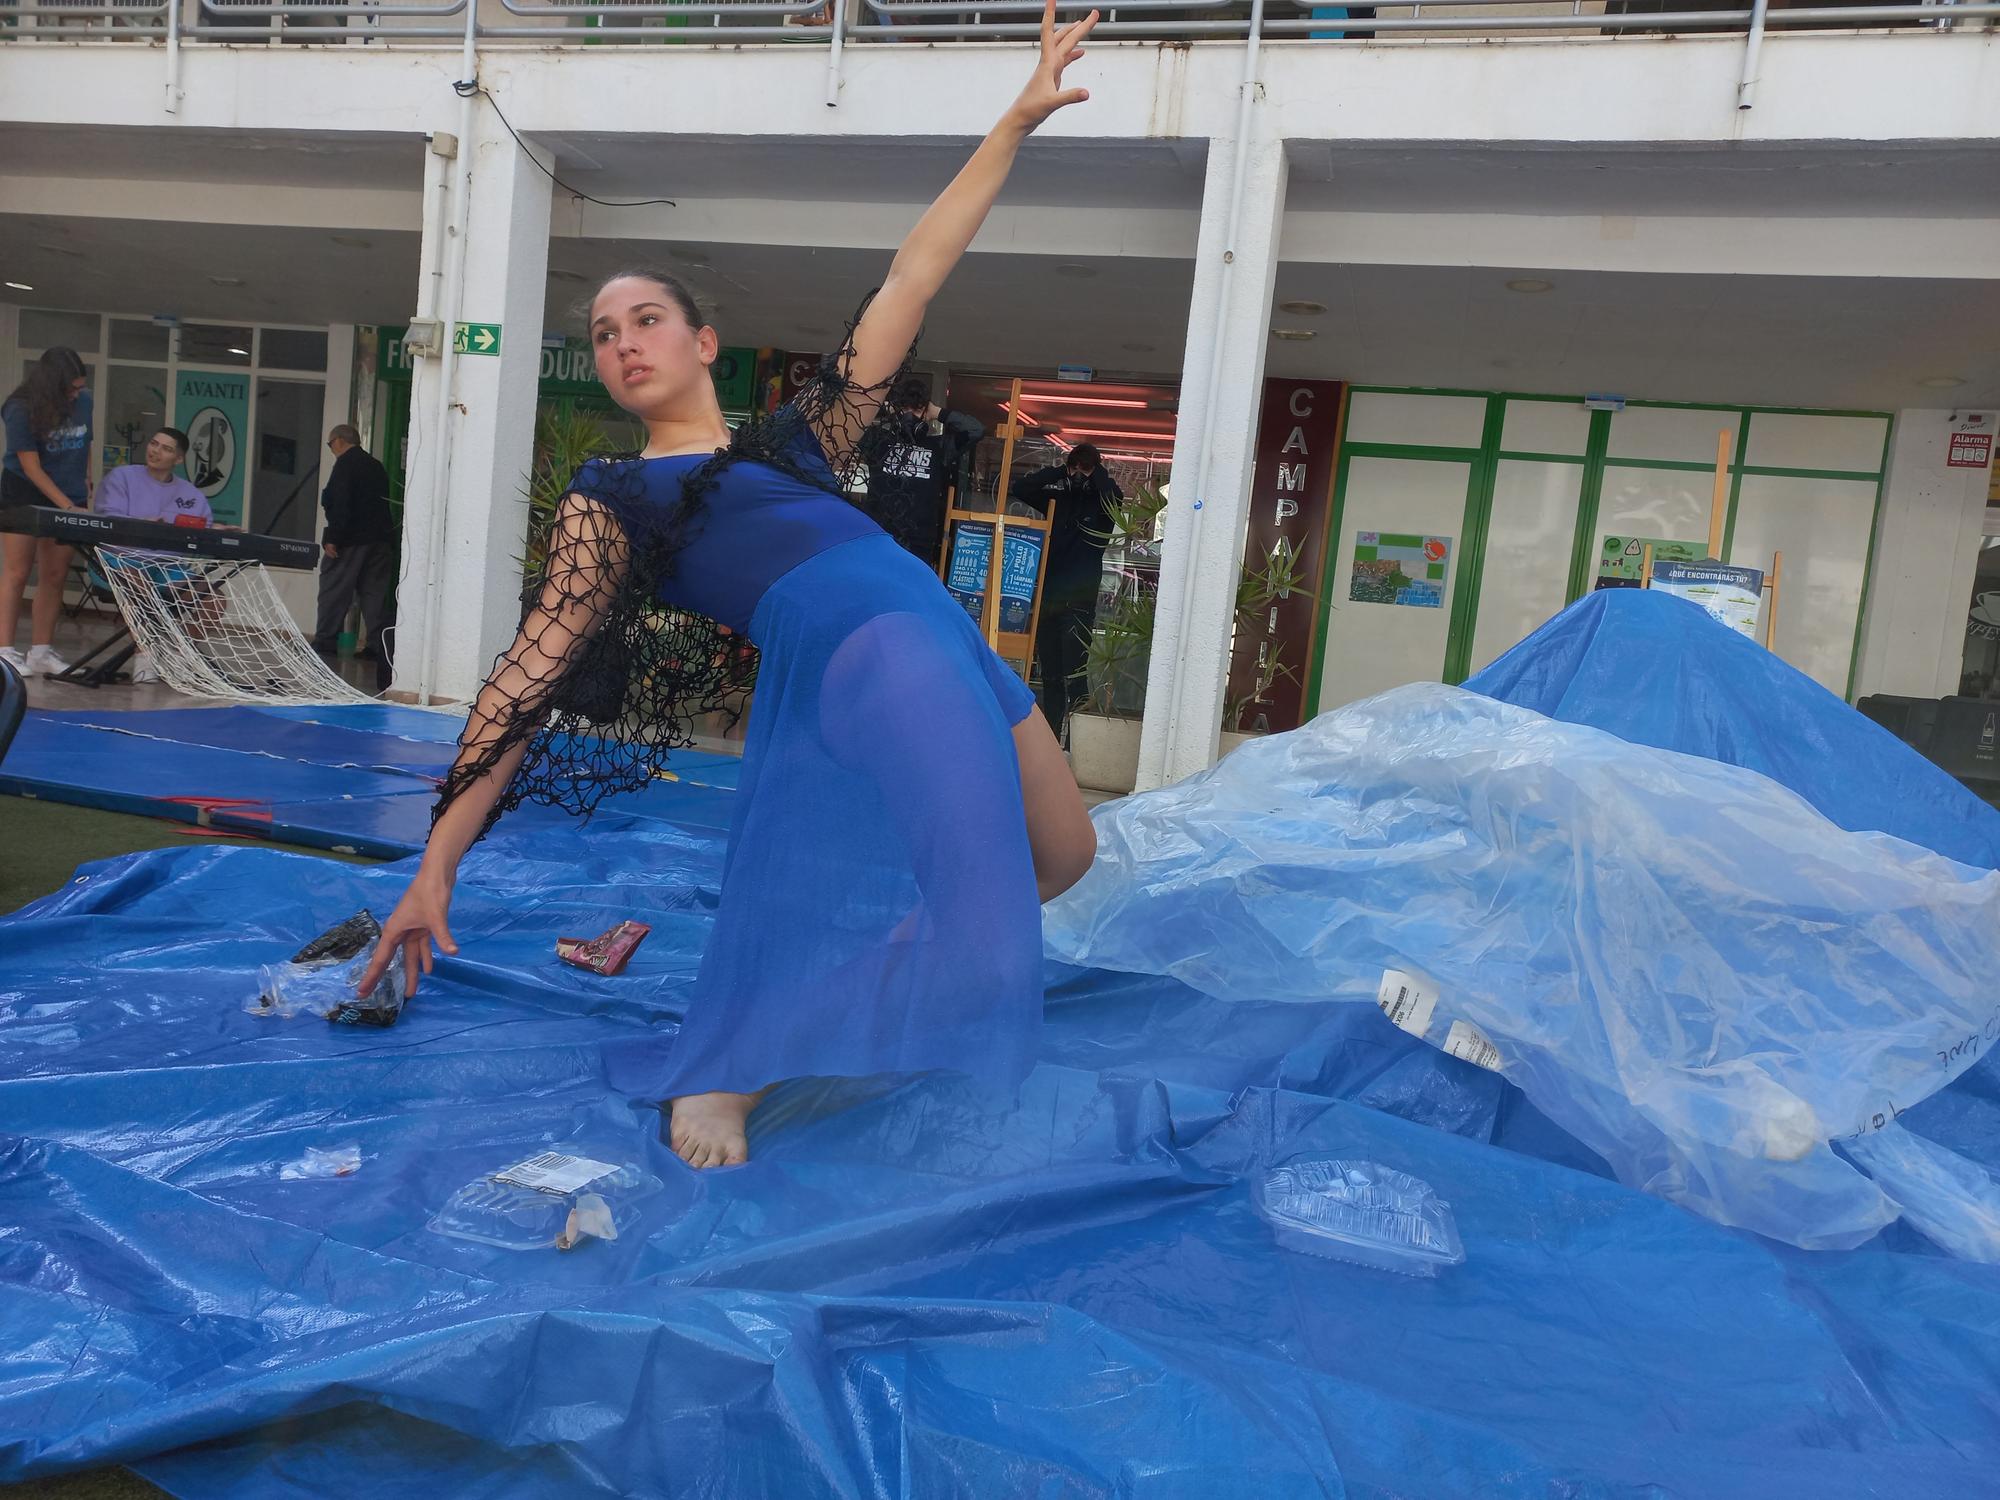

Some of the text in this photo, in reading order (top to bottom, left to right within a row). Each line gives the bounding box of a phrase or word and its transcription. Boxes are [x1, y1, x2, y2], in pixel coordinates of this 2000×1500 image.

[183, 380, 244, 400] AVANTI
[1953, 434, 1989, 444] Alarma
[54, 514, 113, 530] MEDELI
[1014, 546, 1024, 569] POLLO
[952, 575, 974, 583] PLÁSTICO
[1013, 575, 1034, 584] LÁMPARA
[1669, 570, 1685, 578] ¿QUÉ
[1687, 571, 1734, 583] ENCONTRARÁS
